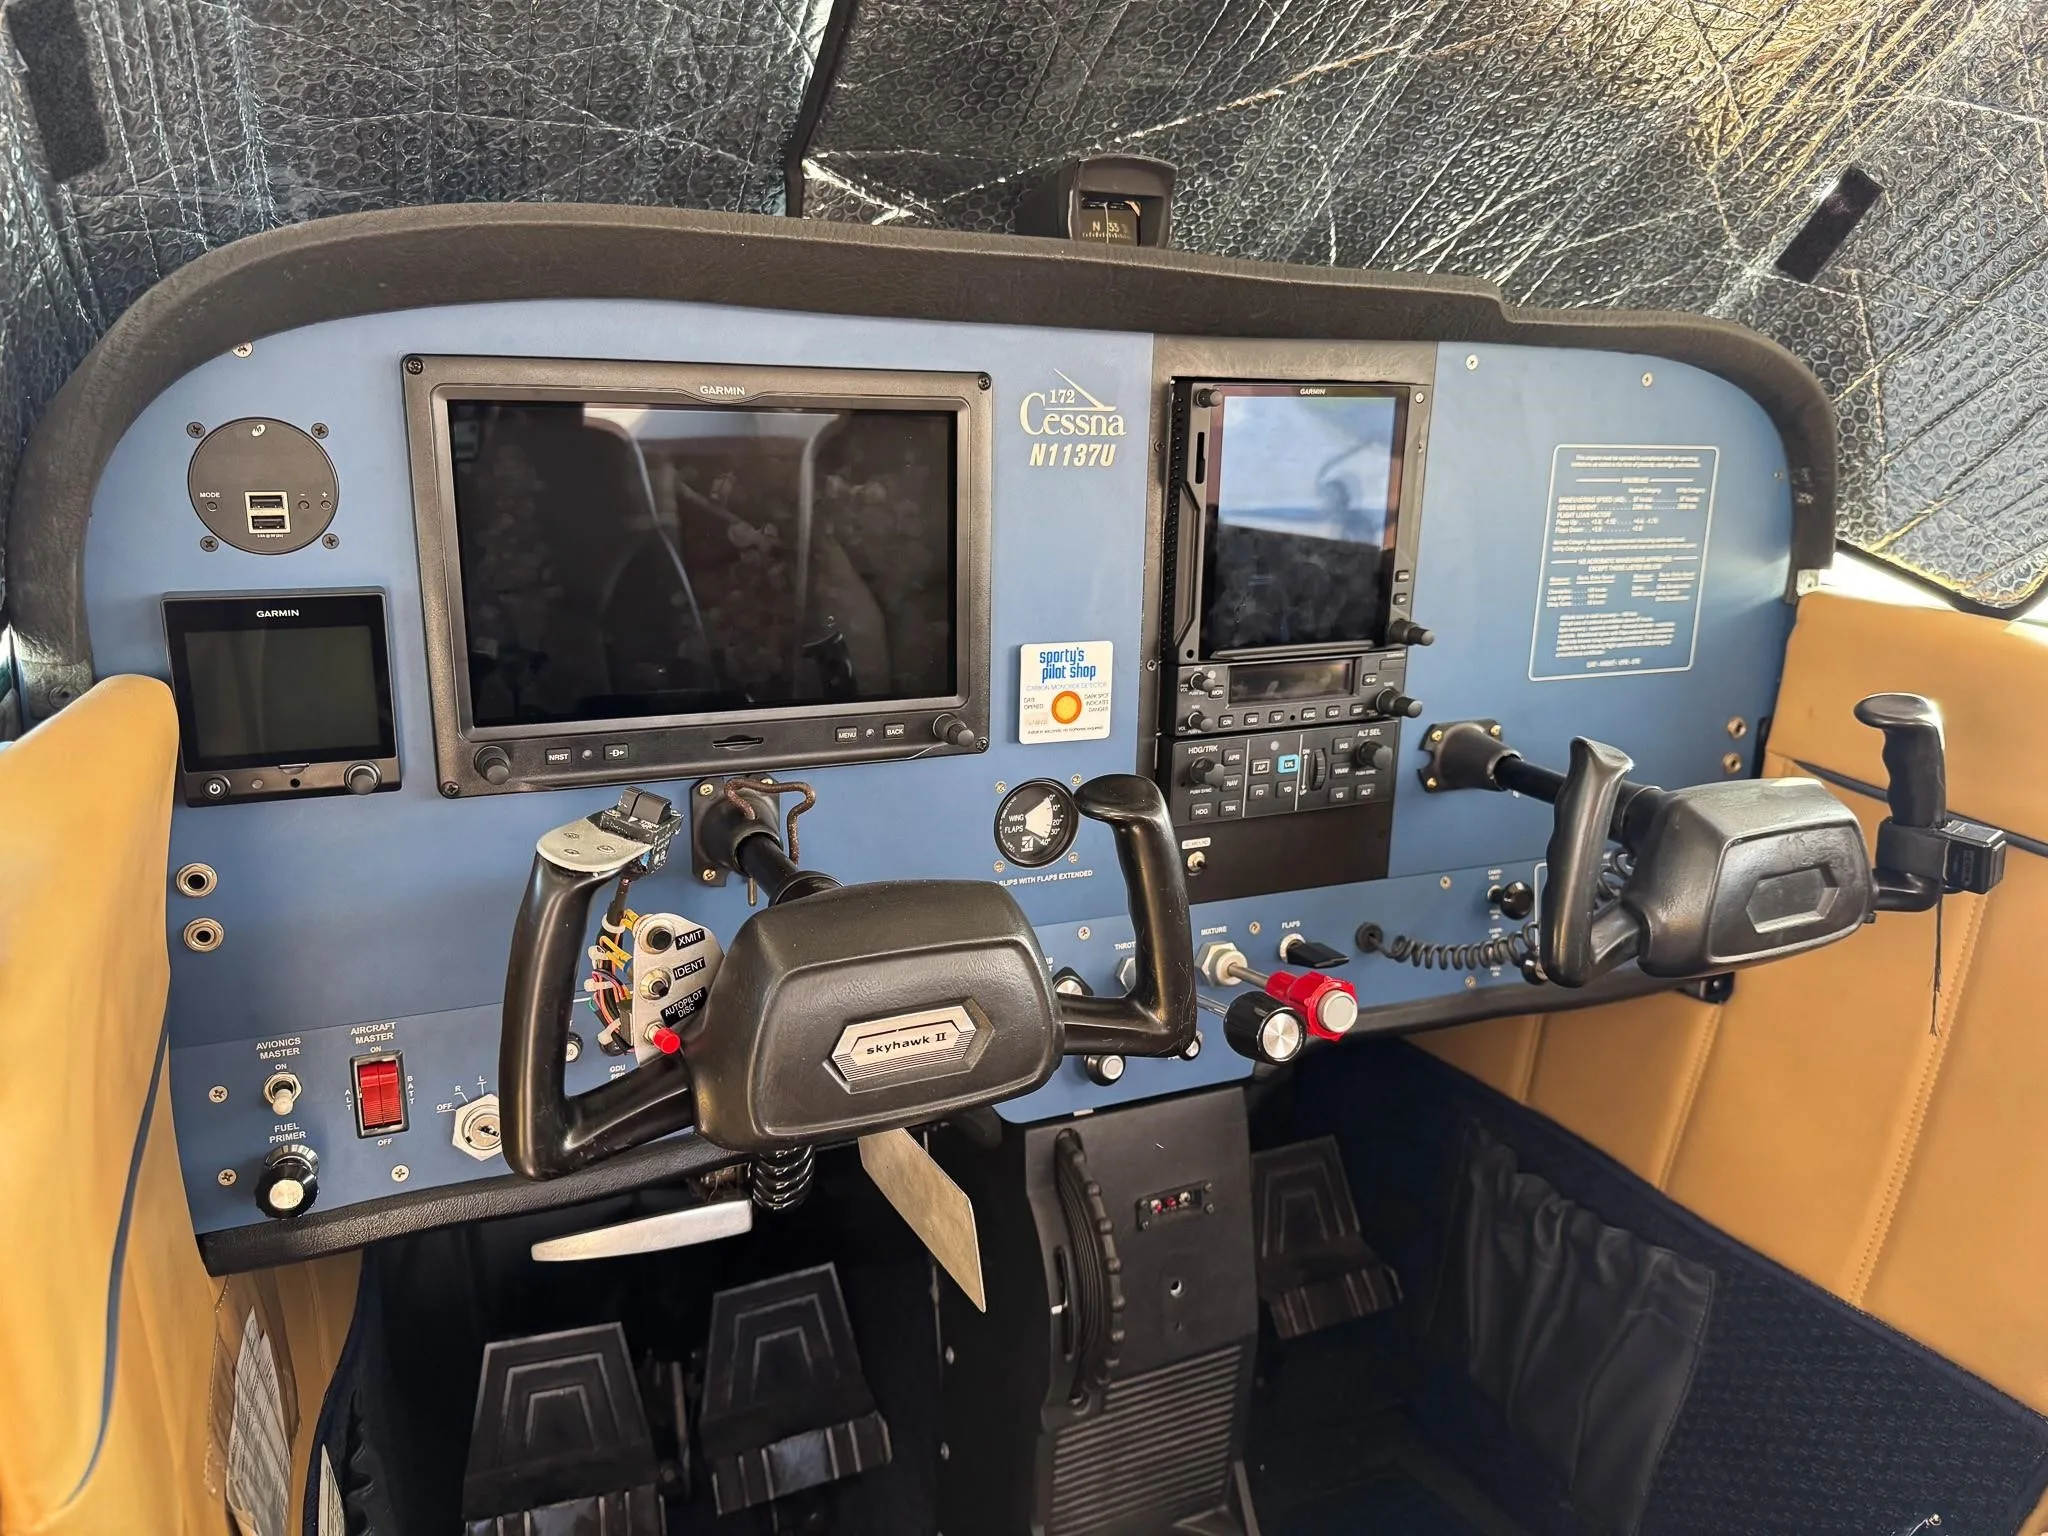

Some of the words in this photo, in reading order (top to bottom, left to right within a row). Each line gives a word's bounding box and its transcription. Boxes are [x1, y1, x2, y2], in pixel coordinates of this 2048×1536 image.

[700, 385, 745, 395] GARMIN
[1050, 388, 1075, 404] 172
[1020, 392, 1127, 436] Cessna
[1029, 443, 1116, 467] N1137U
[256, 609, 300, 618] GARMIN
[1039, 647, 1084, 667] sporty's
[1042, 664, 1067, 684] pilot
[1070, 663, 1096, 680] shop
[1357, 729, 1369, 737] ALT
[1369, 728, 1382, 736] SEL
[1188, 745, 1218, 754] HDG/TRK
[548, 753, 569, 761] NRST
[1195, 808, 1208, 816] HDG
[1008, 814, 1024, 822] WING
[1004, 825, 1024, 833] FLAPS
[999, 878, 1018, 887] SLIPS
[1037, 874, 1058, 882] FLAPS
[1058, 869, 1093, 880] EXTENDED
[1281, 920, 1301, 929] FLAPS
[1201, 926, 1227, 936] MIXTURE
[678, 930, 703, 946] XMIT
[1114, 940, 1136, 950] THROT
[674, 959, 704, 978] IDENT
[664, 990, 703, 1016] AUTOPILOT
[678, 1003, 695, 1018] DISC
[350, 1022, 397, 1036] AIRCRAFT
[256, 1037, 301, 1051] AVIONICS
[355, 1032, 394, 1045] MASTER
[866, 1035, 930, 1055] skyhawk
[935, 1031, 947, 1042] II
[260, 1048, 300, 1060] MASTER
[610, 1064, 625, 1073] GDU
[454, 1085, 461, 1093] R
[436, 1102, 453, 1111] OFF
[274, 1122, 300, 1133] FUEL
[269, 1131, 307, 1144] PRIMER
[377, 1138, 393, 1147] OFF
